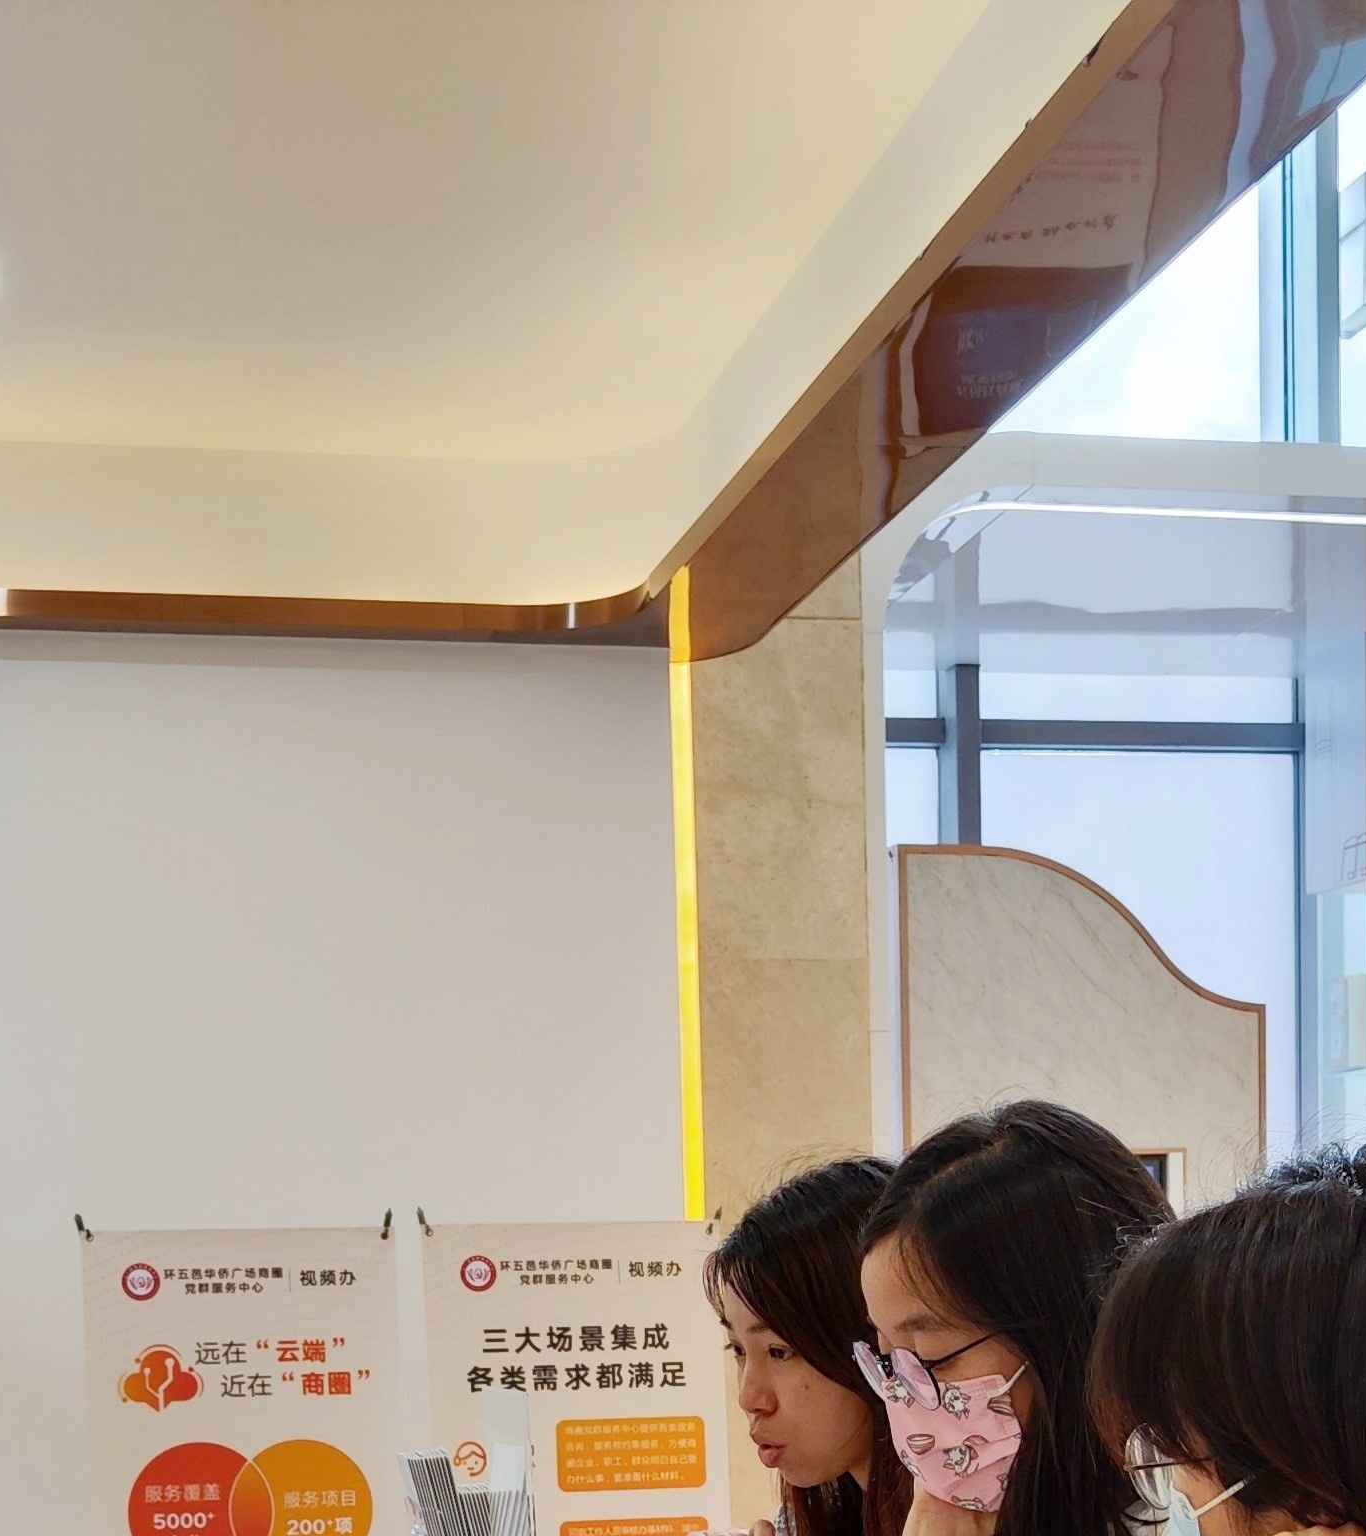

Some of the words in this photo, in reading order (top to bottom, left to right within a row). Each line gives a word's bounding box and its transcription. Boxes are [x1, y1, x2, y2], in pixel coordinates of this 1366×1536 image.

[163, 1267, 283, 1281] 环五邑华侨广场商圈
[500, 1259, 613, 1272] 环五邑华侨广场商圈
[628, 1261, 682, 1278] 视频办
[185, 1281, 264, 1295] 党群服务中心
[300, 1269, 356, 1288] 视频办
[520, 1273, 595, 1286] 党群服务中心
[482, 1322, 670, 1354] 三大场景集成
[195, 1337, 346, 1365] 远在“云端”
[221, 1369, 370, 1398] 近在“商圈”
[466, 1361, 687, 1393] 各类需求都满足
[144, 1483, 222, 1504] 服务覆盖
[284, 1489, 357, 1508] 服务项目
[153, 1511, 215, 1530] 5000+
[286, 1517, 353, 1536] 200+项
